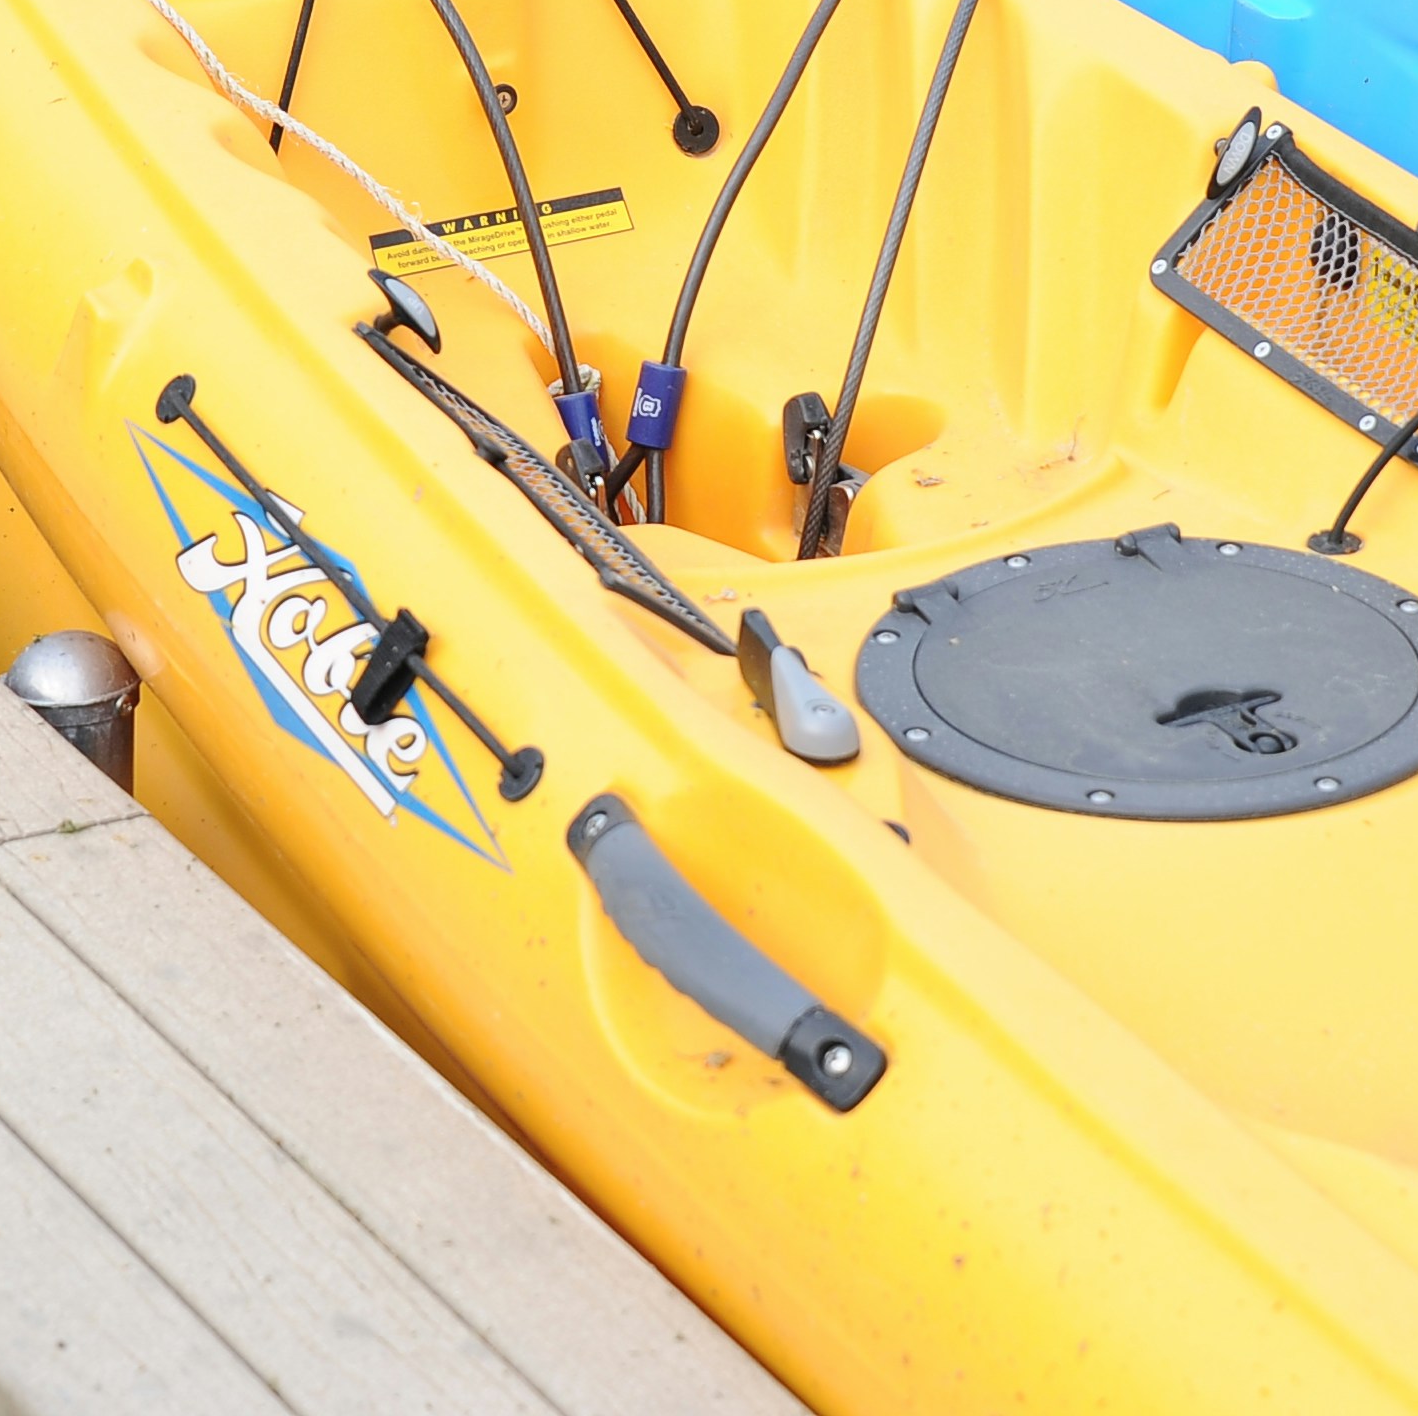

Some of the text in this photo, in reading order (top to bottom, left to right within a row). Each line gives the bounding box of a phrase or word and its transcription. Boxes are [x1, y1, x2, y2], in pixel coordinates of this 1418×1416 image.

[1222, 131, 1252, 175] DOWN
[387, 248, 411, 260] Avoid
[542, 218, 570, 230] ushing
[571, 213, 594, 224] either
[595, 208, 618, 220] pedal
[441, 203, 553, 234] WARNIG
[397, 254, 430, 269] forward
[463, 244, 497, 256] eaching
[497, 241, 506, 249] or
[556, 225, 587, 238] shallow
